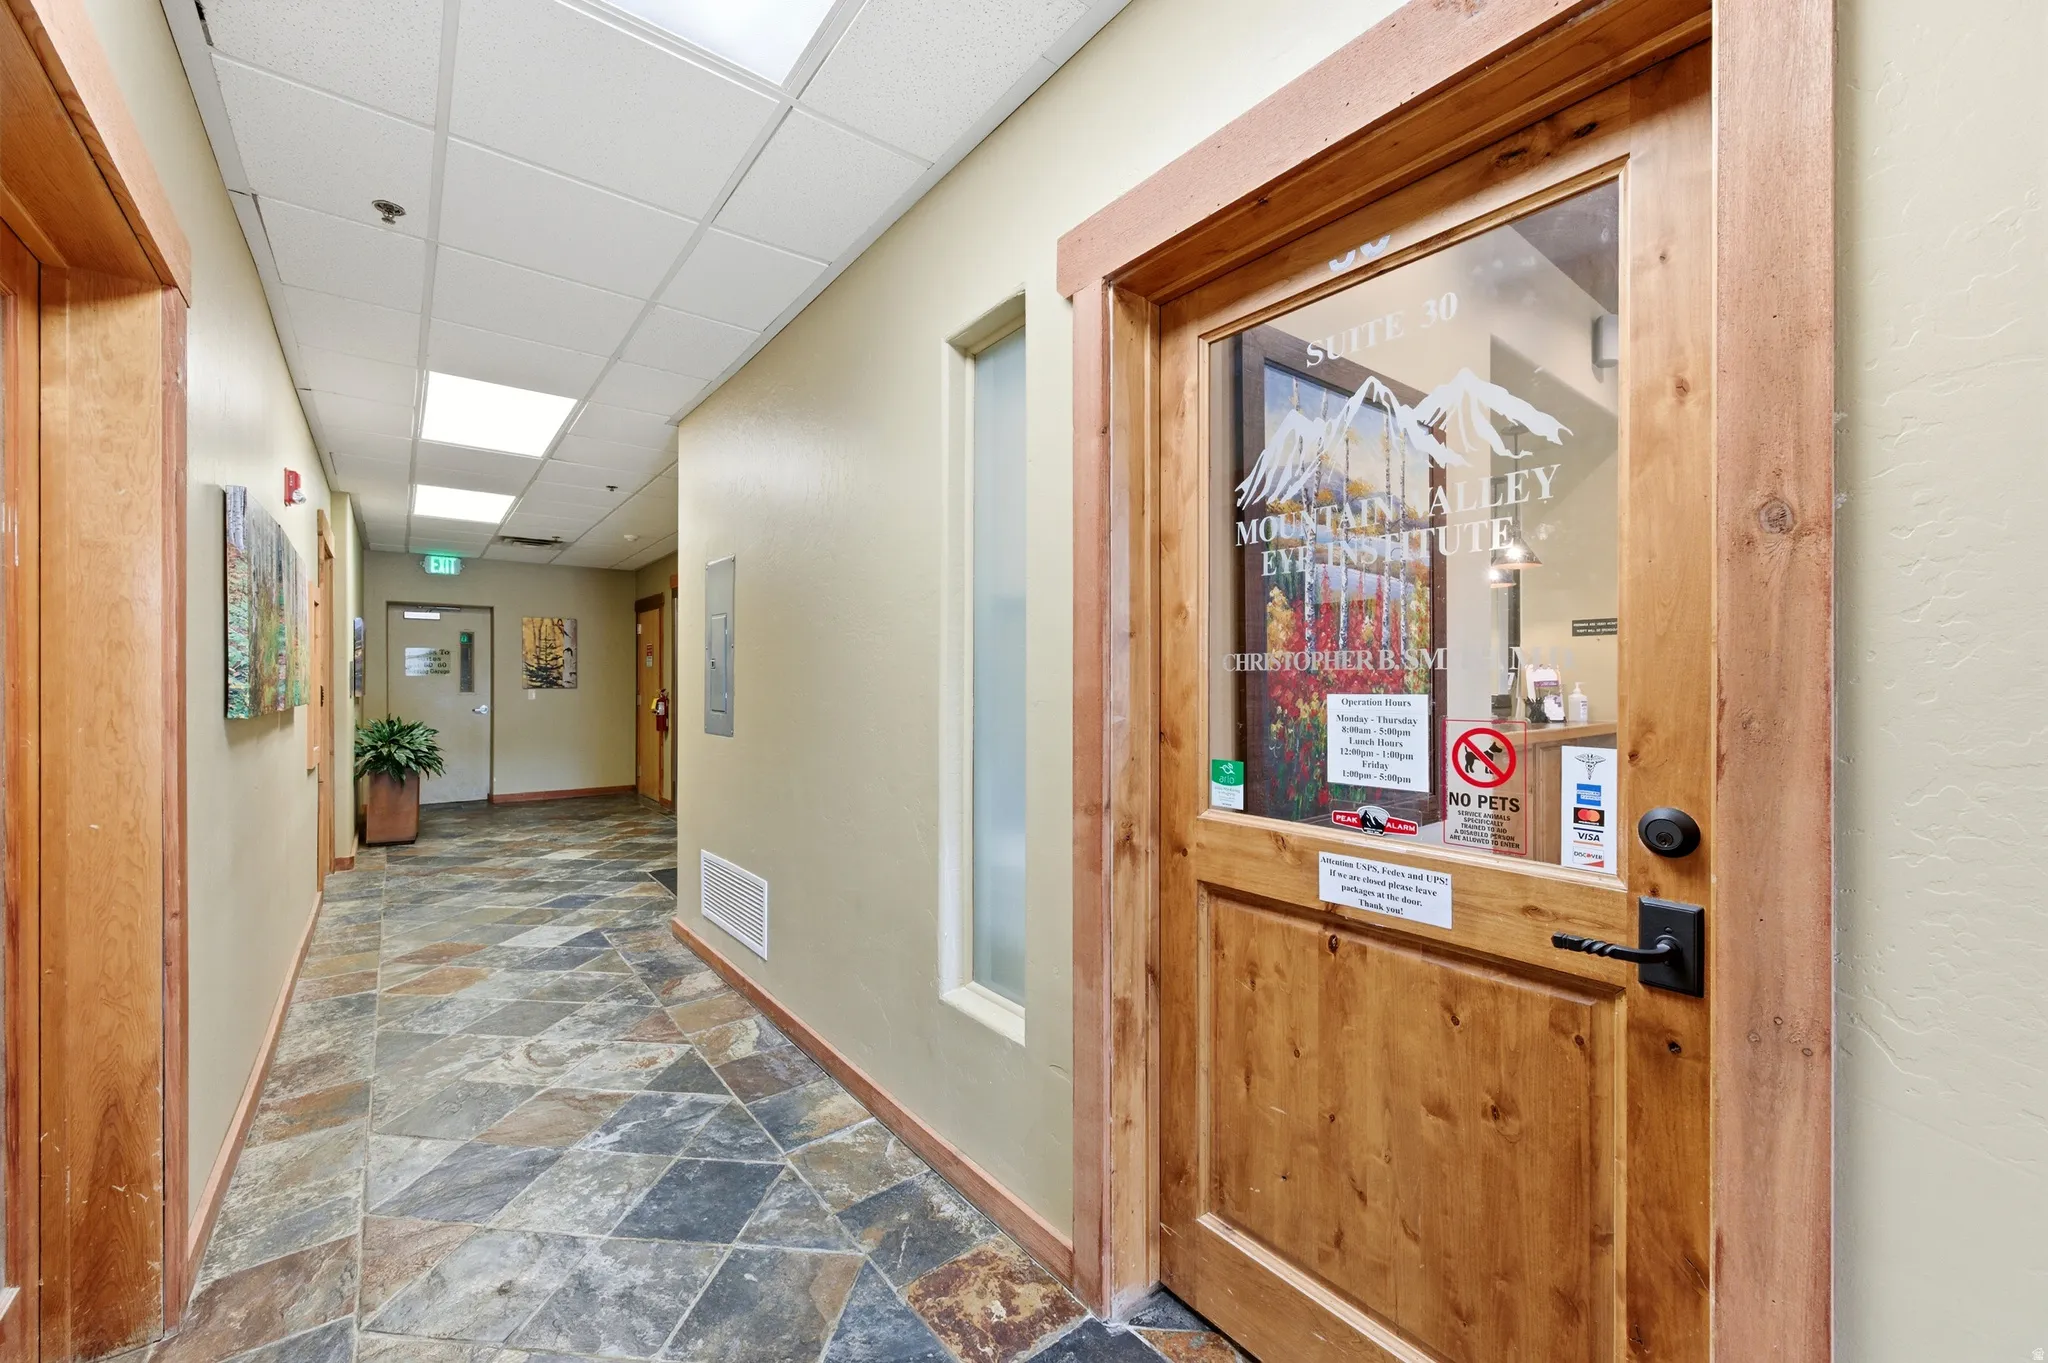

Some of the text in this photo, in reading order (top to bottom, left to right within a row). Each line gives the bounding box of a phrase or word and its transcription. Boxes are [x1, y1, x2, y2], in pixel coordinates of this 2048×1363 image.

[1306, 291, 1458, 368] SUITE 30
[1235, 492, 1396, 548] MOUNTAIN
[1261, 516, 1515, 577] EYE INSTITUTE
[430, 556, 456, 574] EXIT
[1222, 649, 1375, 672] CHRISTOPHER
[1379, 649, 1400, 671] B.
[1341, 698, 1412, 708] Operation Hours
[1336, 714, 1369, 725] Monday
[1376, 715, 1418, 727] Thursday
[1341, 726, 1371, 734] 8:00am
[1379, 728, 1411, 737] 5:00pm
[1349, 737, 1404, 748] Lunch Hours
[1340, 748, 1374, 758] 12:00pm
[1382, 750, 1414, 761] 1:00pm
[1362, 760, 1390, 771] Friday
[1342, 770, 1372, 780] 1:00pm
[1379, 773, 1411, 784] 5:00pm
[1449, 792, 1520, 812] NO PETS
[1457, 810, 1511, 821] SERVICE ANIMALS
[1463, 817, 1504, 827] SPECIFICALLY
[1335, 814, 1358, 824] PEAK
[1386, 822, 1416, 832] ALARM
[1461, 823, 1486, 831] TRAINED
[1460, 829, 1489, 838] DISABLED
[1490, 834, 1515, 842] PERSON
[1463, 835, 1490, 845] ALLOWED
[1500, 840, 1520, 849] ENTER
[1577, 831, 1601, 842] VISA
[1320, 856, 1449, 886] Attention USPS, Fedex and UPS!
[1329, 869, 1336, 877] If
[1348, 874, 1360, 882] are
[1362, 876, 1387, 887] closed
[1388, 881, 1414, 892] please
[1415, 884, 1438, 897] leave
[1341, 884, 1423, 907] packages at the door.
[1358, 898, 1404, 916] Thank you!
